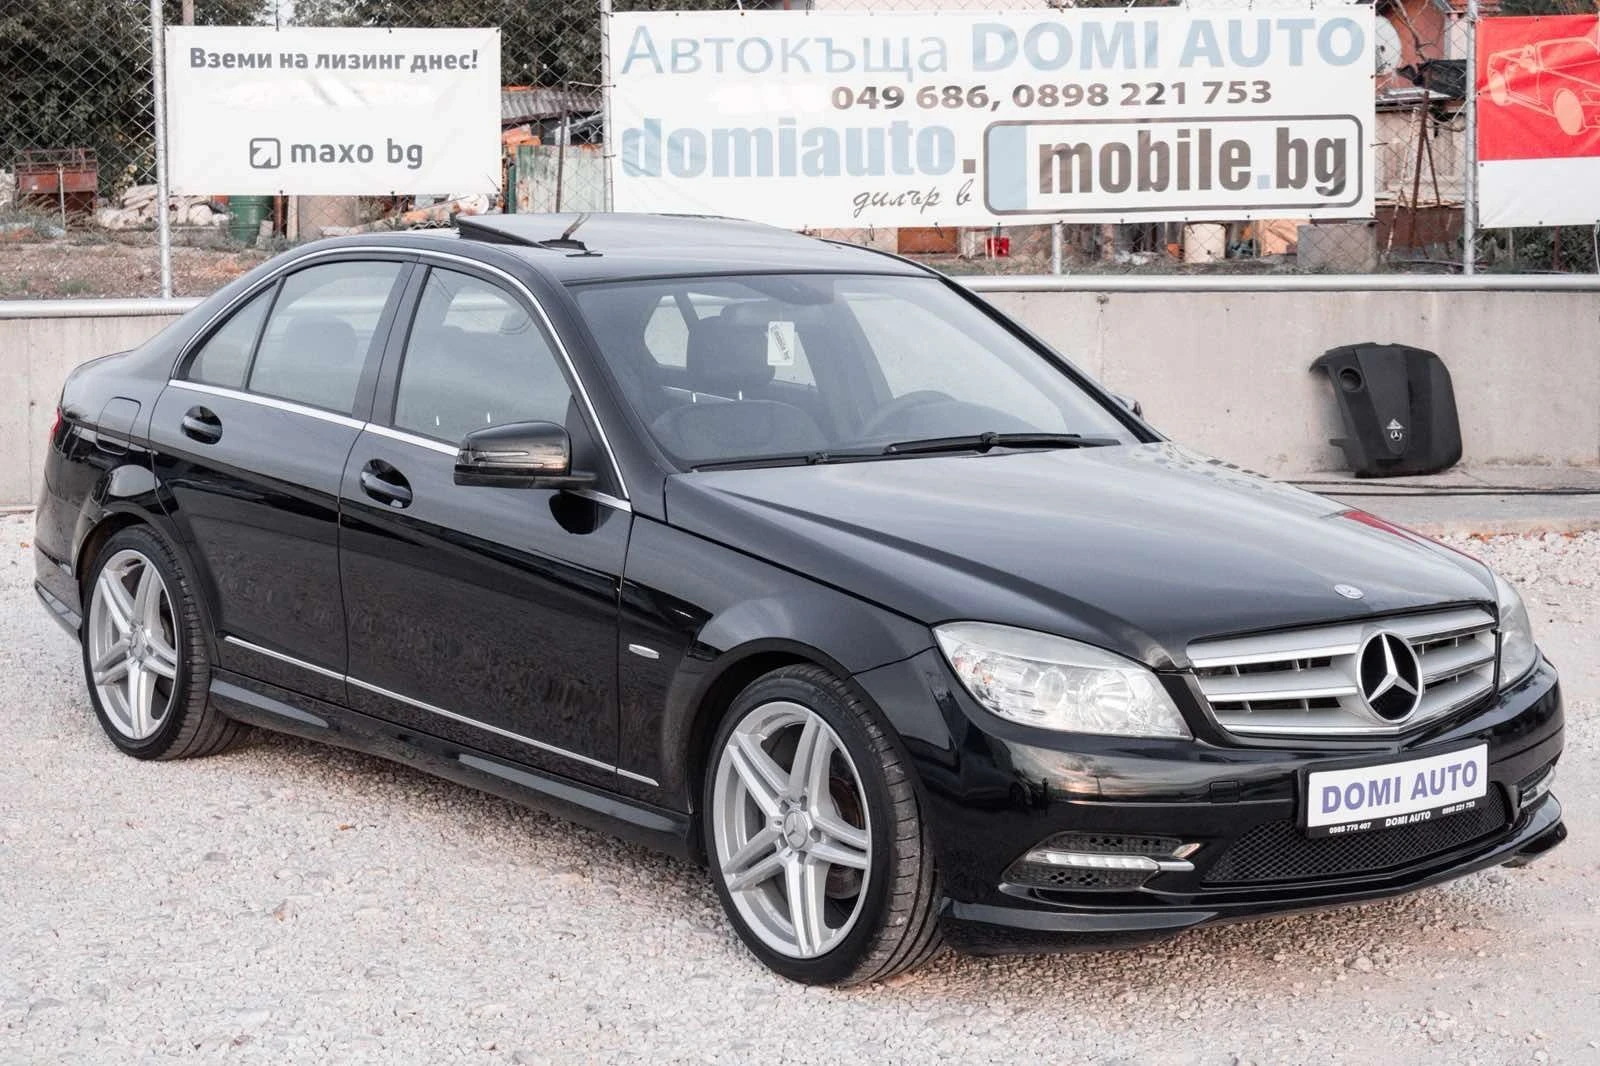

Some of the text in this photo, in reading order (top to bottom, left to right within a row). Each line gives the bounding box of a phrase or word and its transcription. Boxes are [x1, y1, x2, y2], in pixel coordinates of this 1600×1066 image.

[189, 47, 479, 74] Вземи на лизинг днес!
[620, 16, 1365, 83] Автокъща DOMI AUTO
[830, 80, 1272, 112] 049 686, 0898 221 753
[290, 138, 424, 170] maxo bg
[1321, 760, 1478, 814] DOMI AUTO
[1385, 810, 1431, 827] DOMI AUTO
